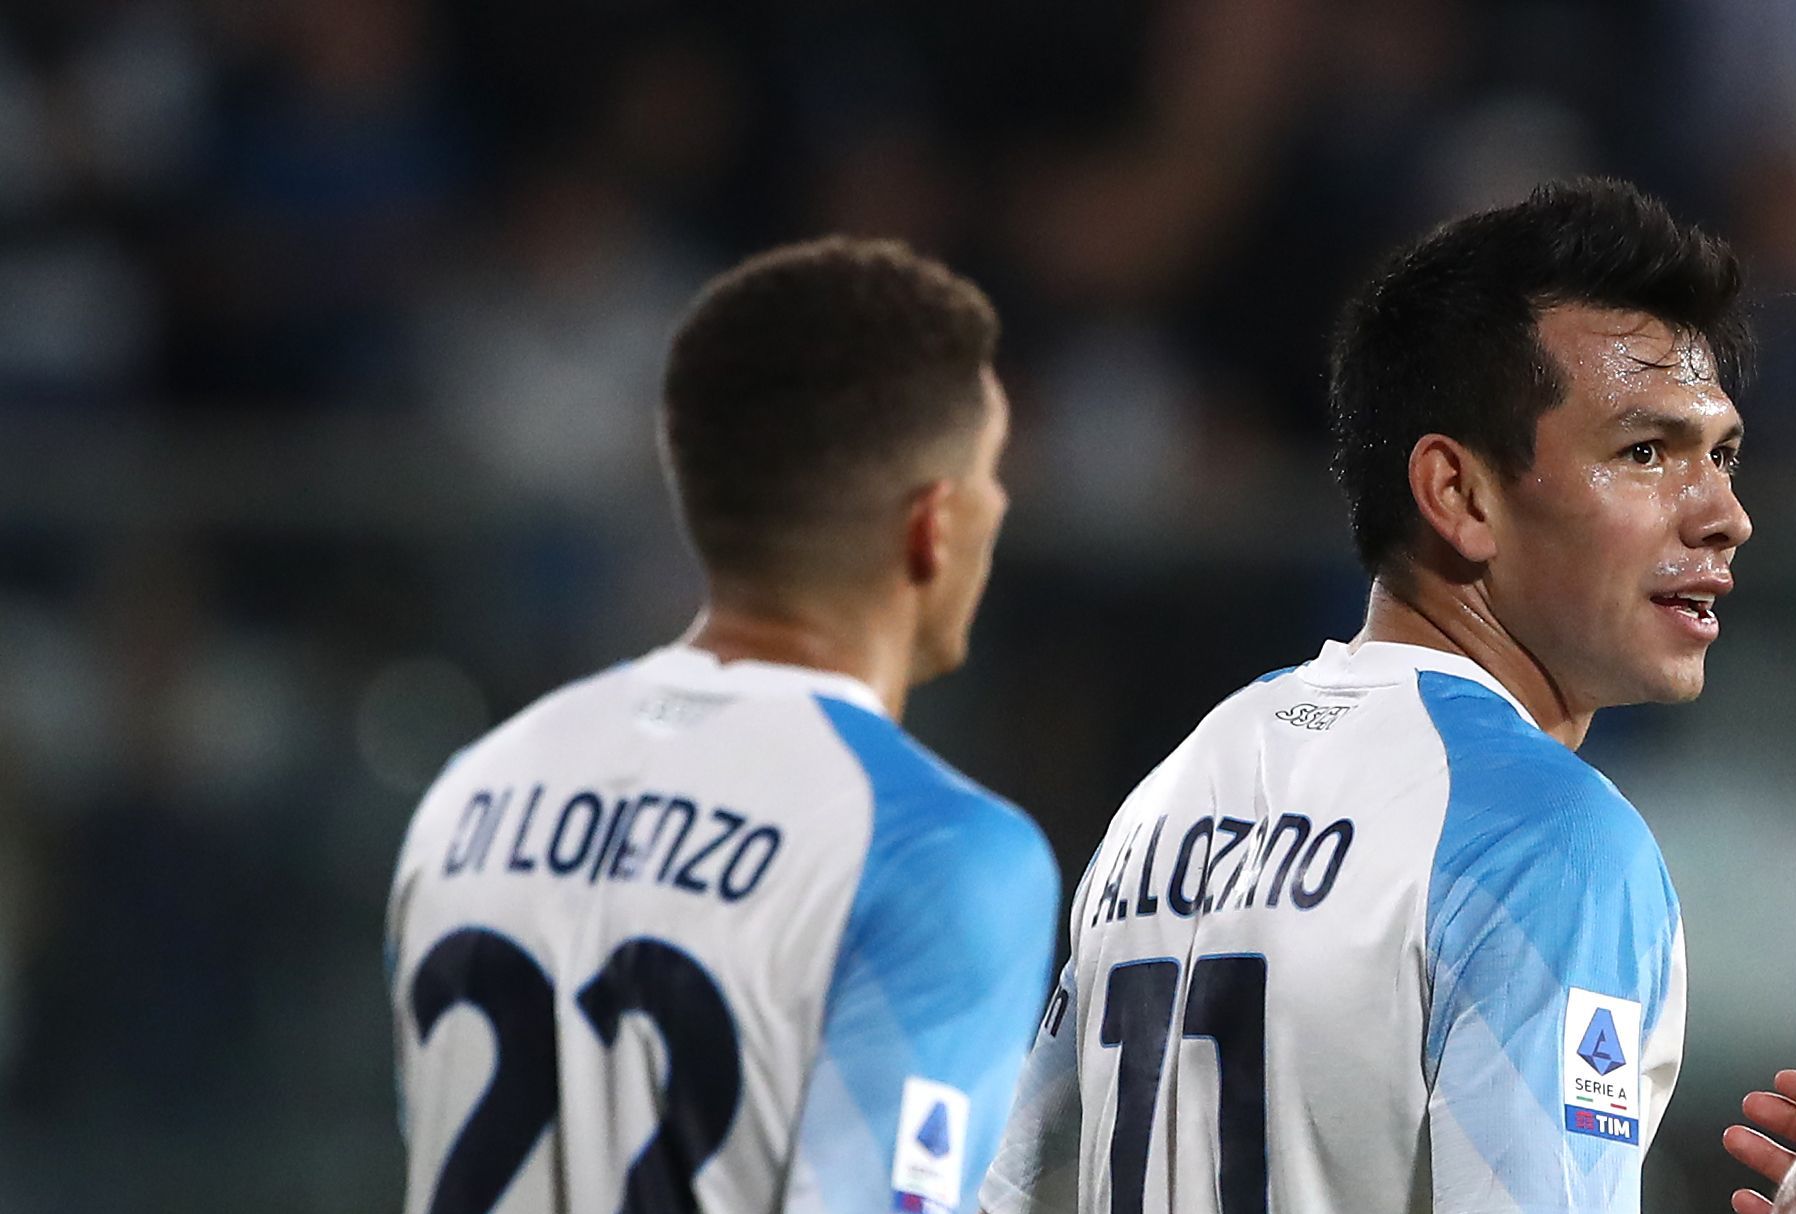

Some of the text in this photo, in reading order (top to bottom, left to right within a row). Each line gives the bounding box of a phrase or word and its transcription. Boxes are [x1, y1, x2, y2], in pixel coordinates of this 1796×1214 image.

[1575, 1077, 1627, 1101] SERIE A
[1595, 1114, 1631, 1139] TIM
